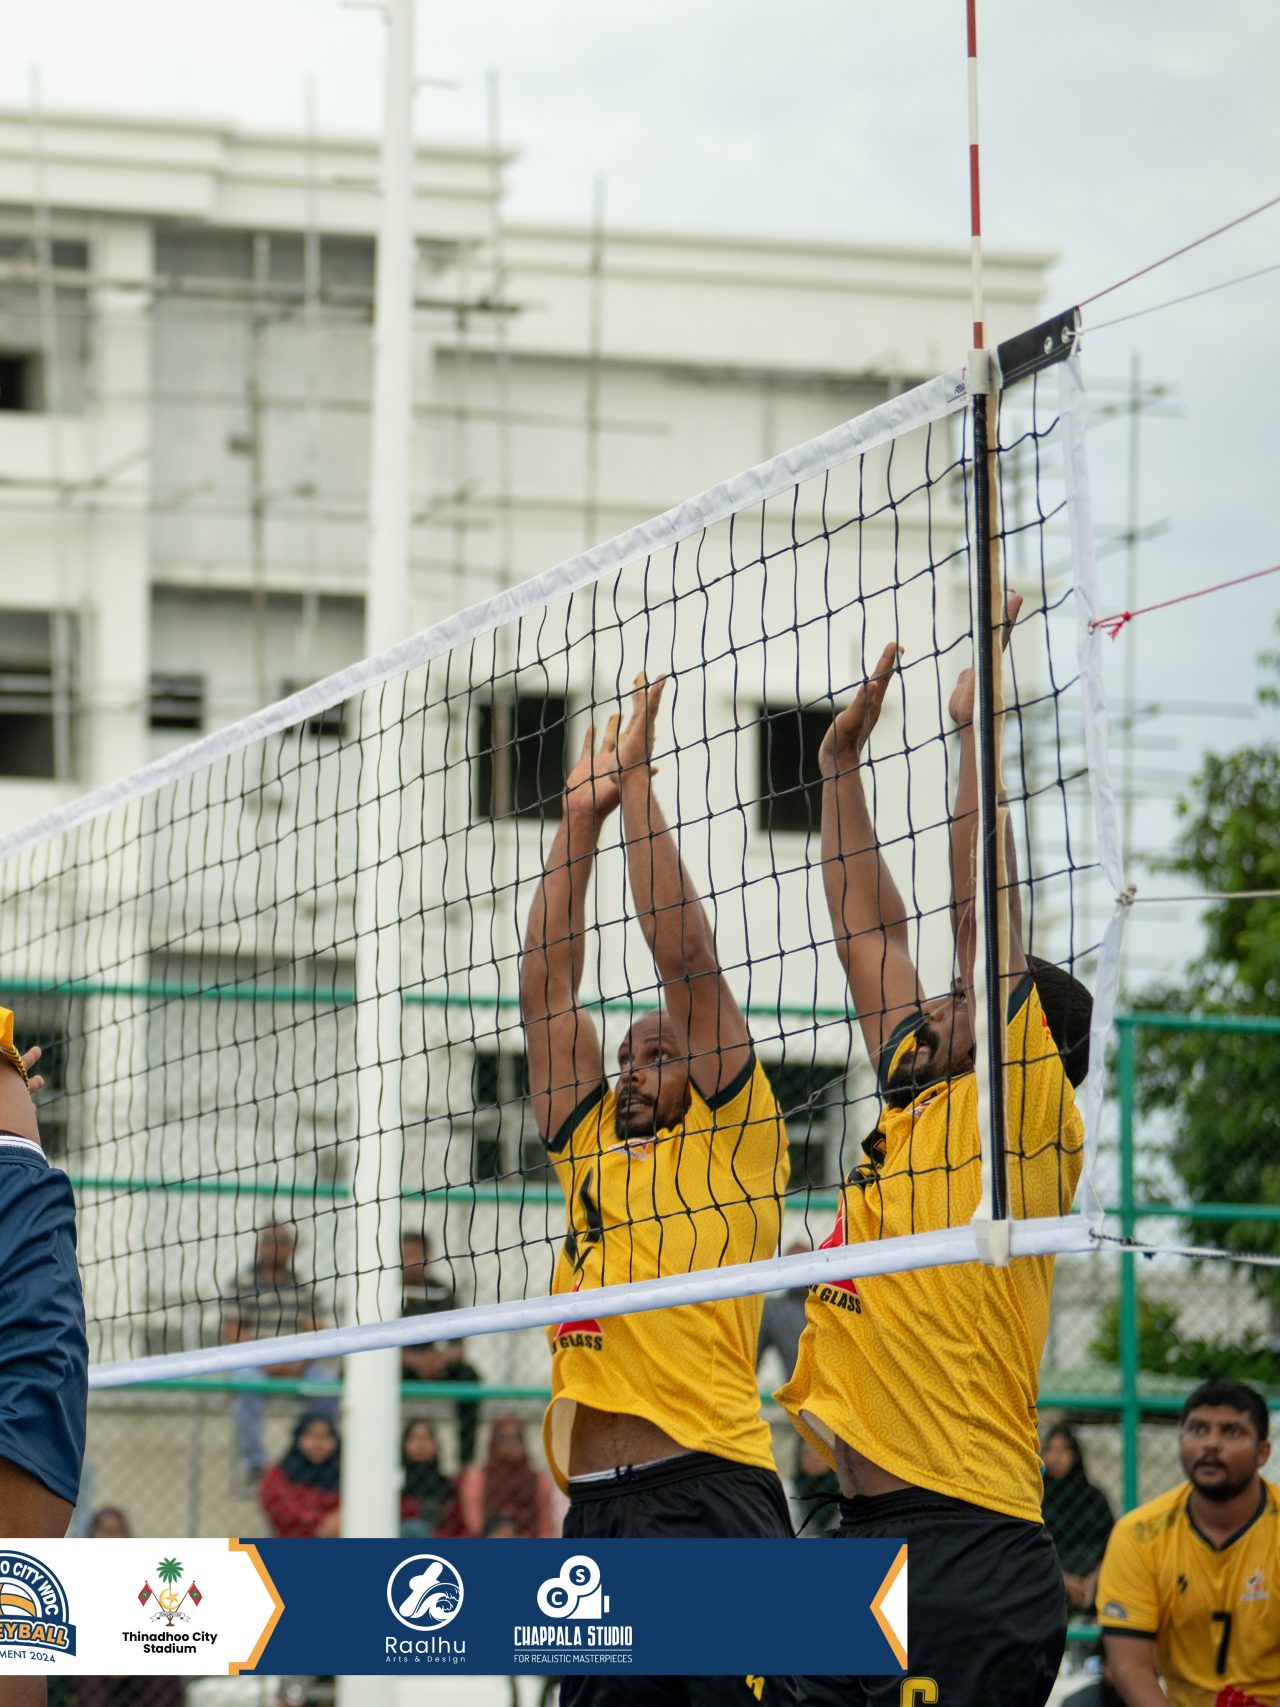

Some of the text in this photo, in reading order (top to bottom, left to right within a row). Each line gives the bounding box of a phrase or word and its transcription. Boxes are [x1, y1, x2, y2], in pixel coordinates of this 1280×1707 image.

[819, 1287, 861, 1315] GLASS
[559, 1333, 602, 1351] GLASS
[1211, 1611, 1233, 1676] 7
